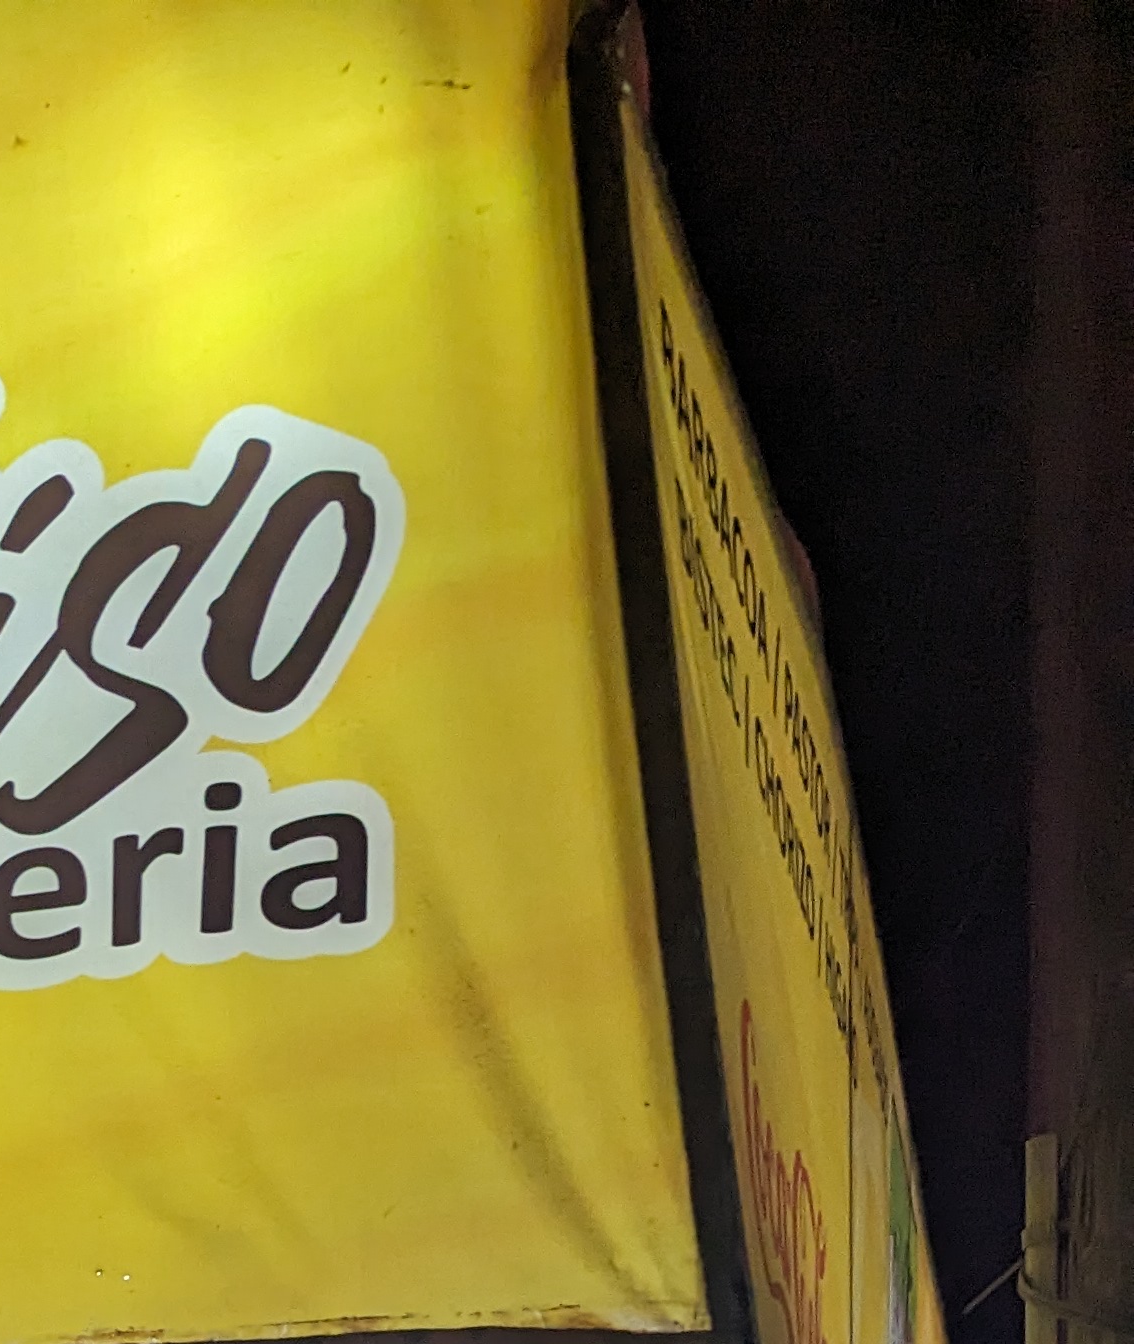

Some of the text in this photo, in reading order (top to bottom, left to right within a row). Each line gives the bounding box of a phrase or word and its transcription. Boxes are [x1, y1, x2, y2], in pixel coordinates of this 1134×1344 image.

[660, 298, 770, 682] BARBACOA
[784, 660, 831, 868] PASTOR
[753, 716, 815, 941] CHORIZO
